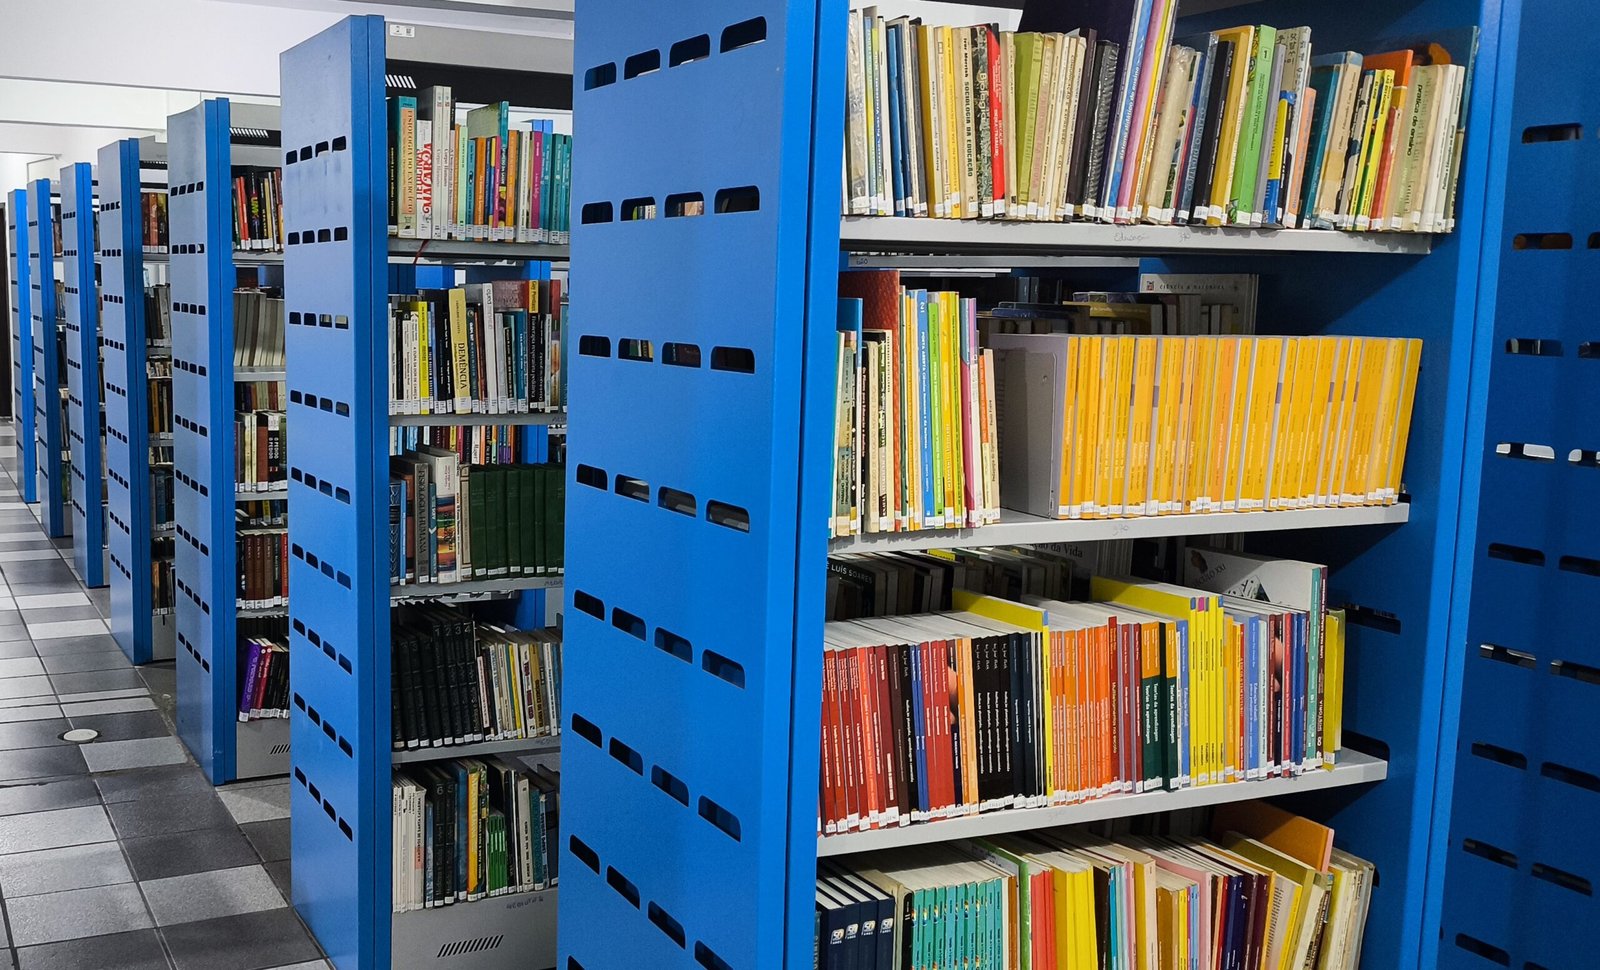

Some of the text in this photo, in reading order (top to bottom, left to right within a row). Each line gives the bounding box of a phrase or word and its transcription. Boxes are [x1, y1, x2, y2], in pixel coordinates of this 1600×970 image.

[964, 81, 974, 176] SOCIOLOGIA DA EDUCAÇÃO
[1410, 115, 1419, 127] de
[1406, 128, 1417, 156] ensino
[407, 157, 414, 169] DO
[458, 342, 467, 389] DEMÊNCIA
[418, 470, 428, 553] FISIOLOGIA HUMANA
[1064, 543, 1083, 558] Vida
[848, 568, 873, 584] SOARES
